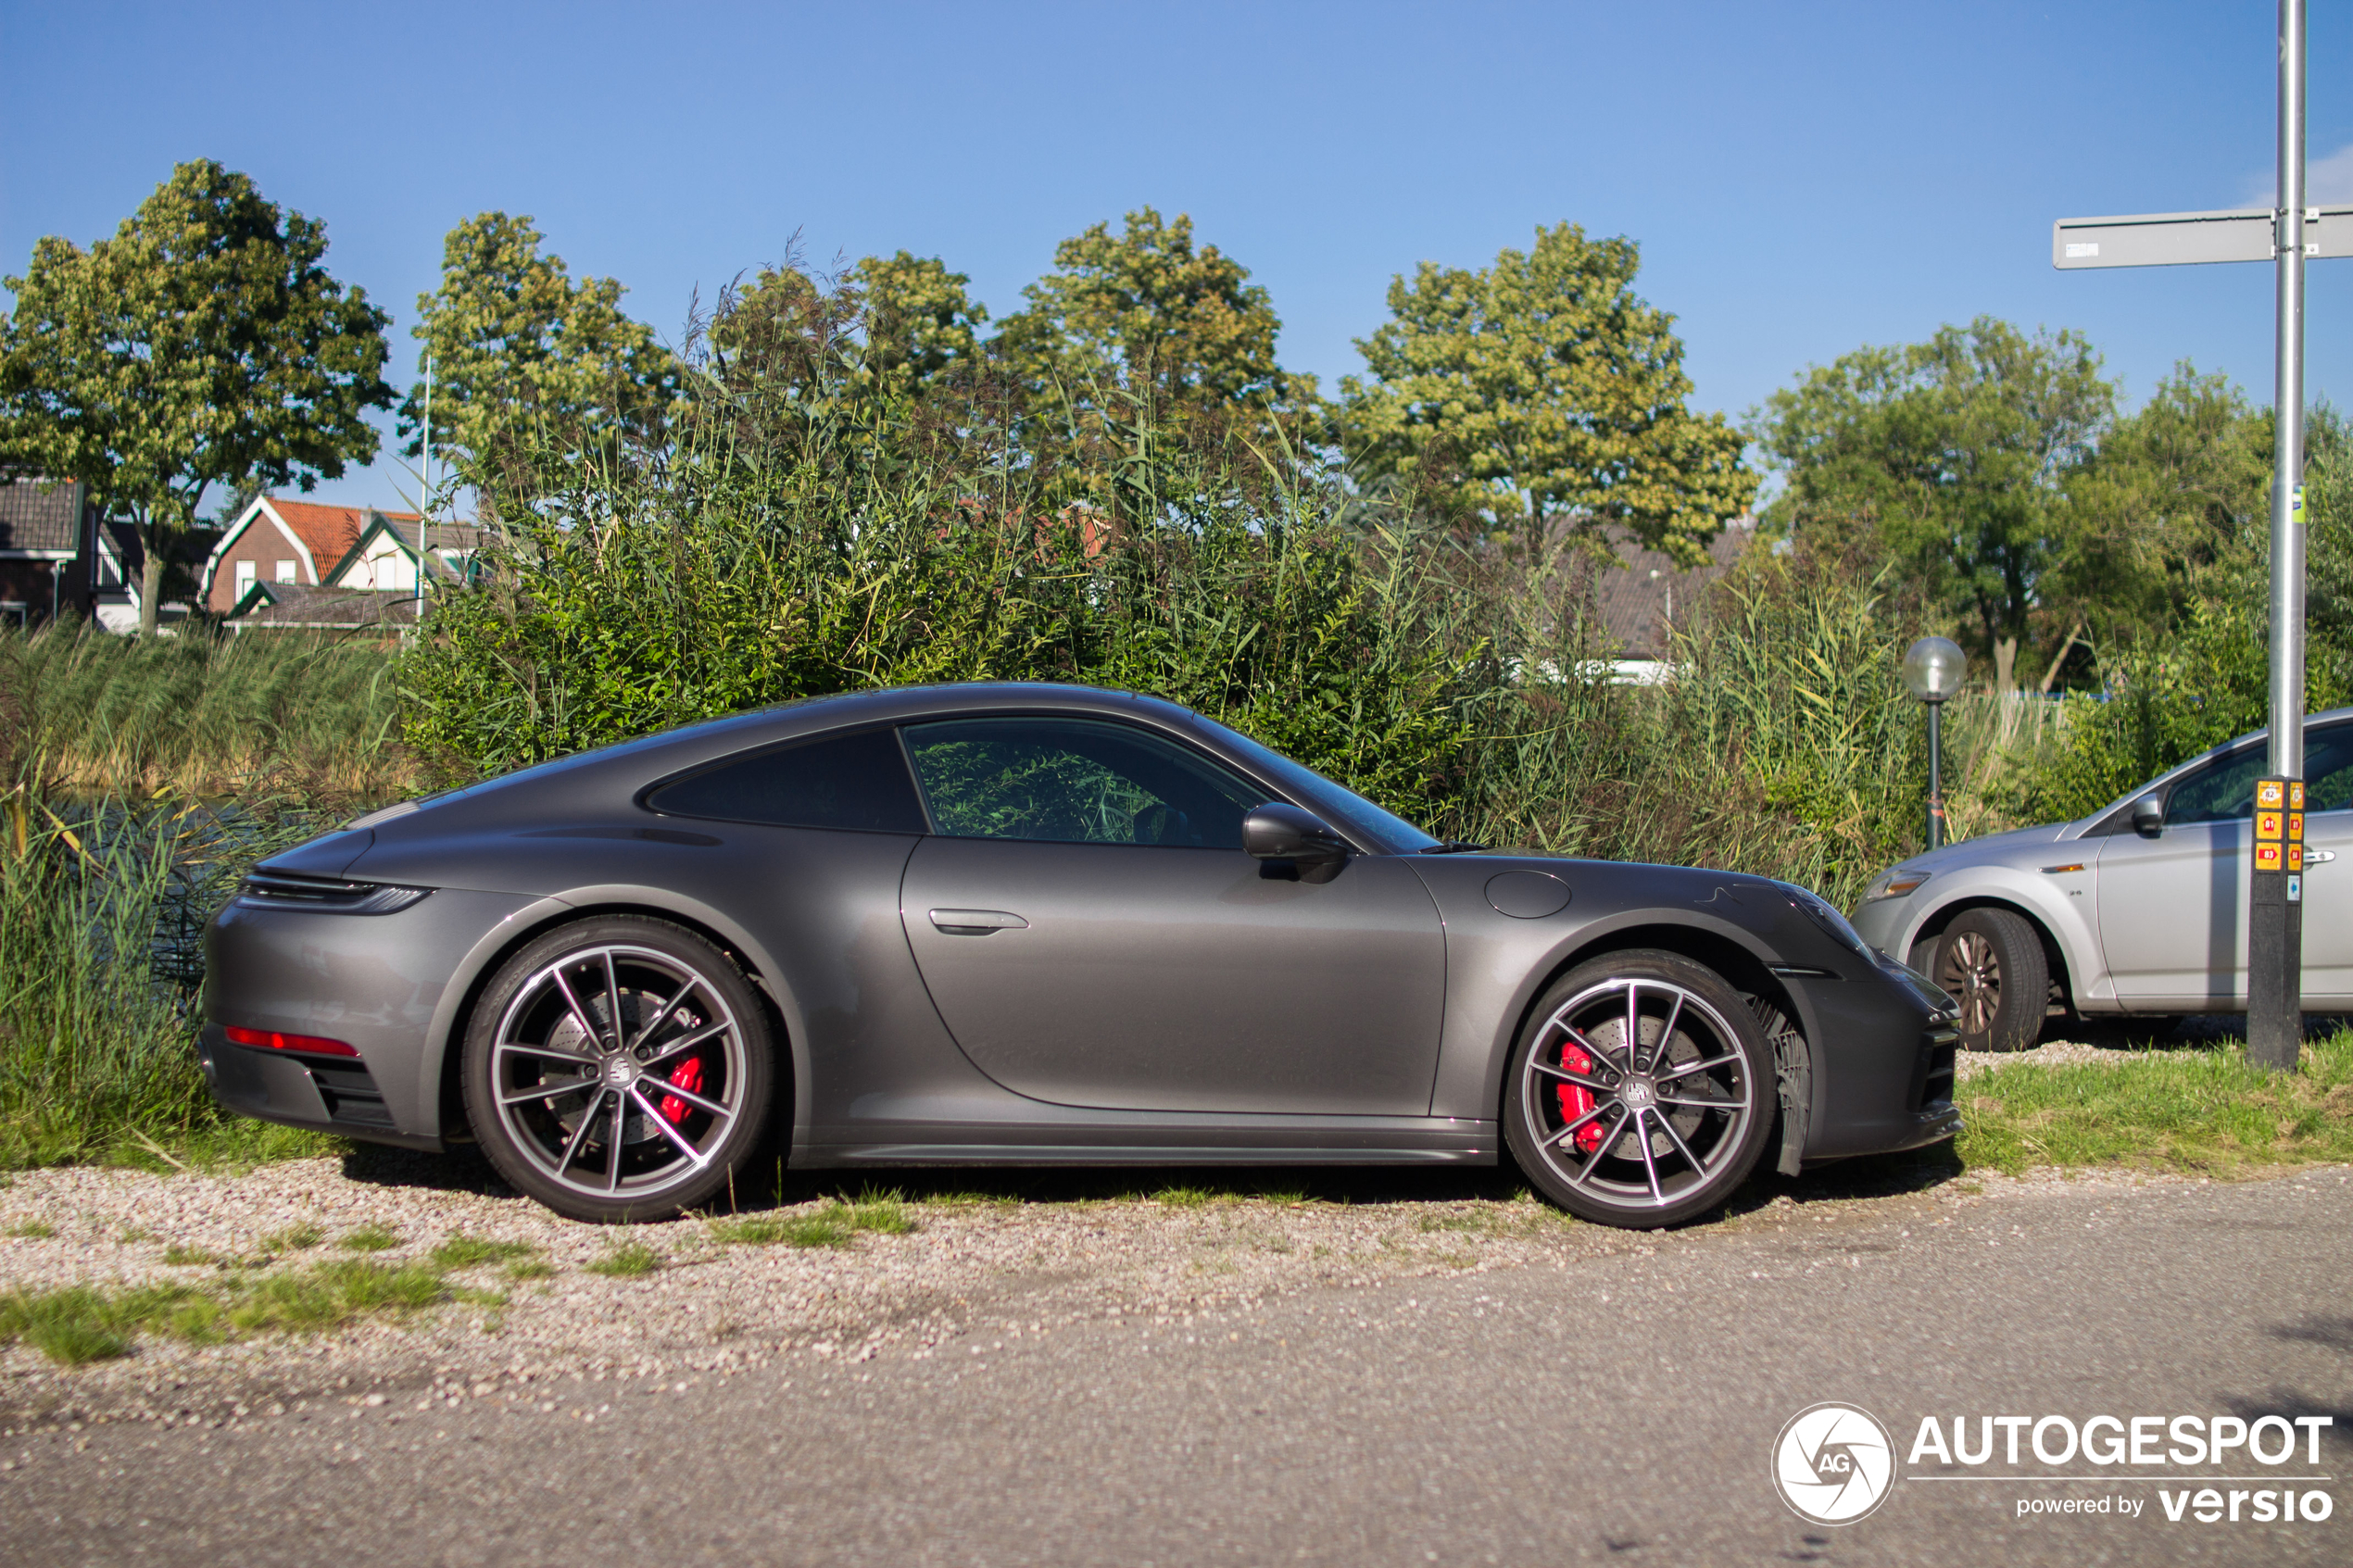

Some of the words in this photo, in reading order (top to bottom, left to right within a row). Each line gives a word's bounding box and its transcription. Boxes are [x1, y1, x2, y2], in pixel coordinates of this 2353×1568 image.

[2265, 790, 2274, 798] 82
[2265, 820, 2274, 828] 81
[2264, 850, 2273, 859] 83
